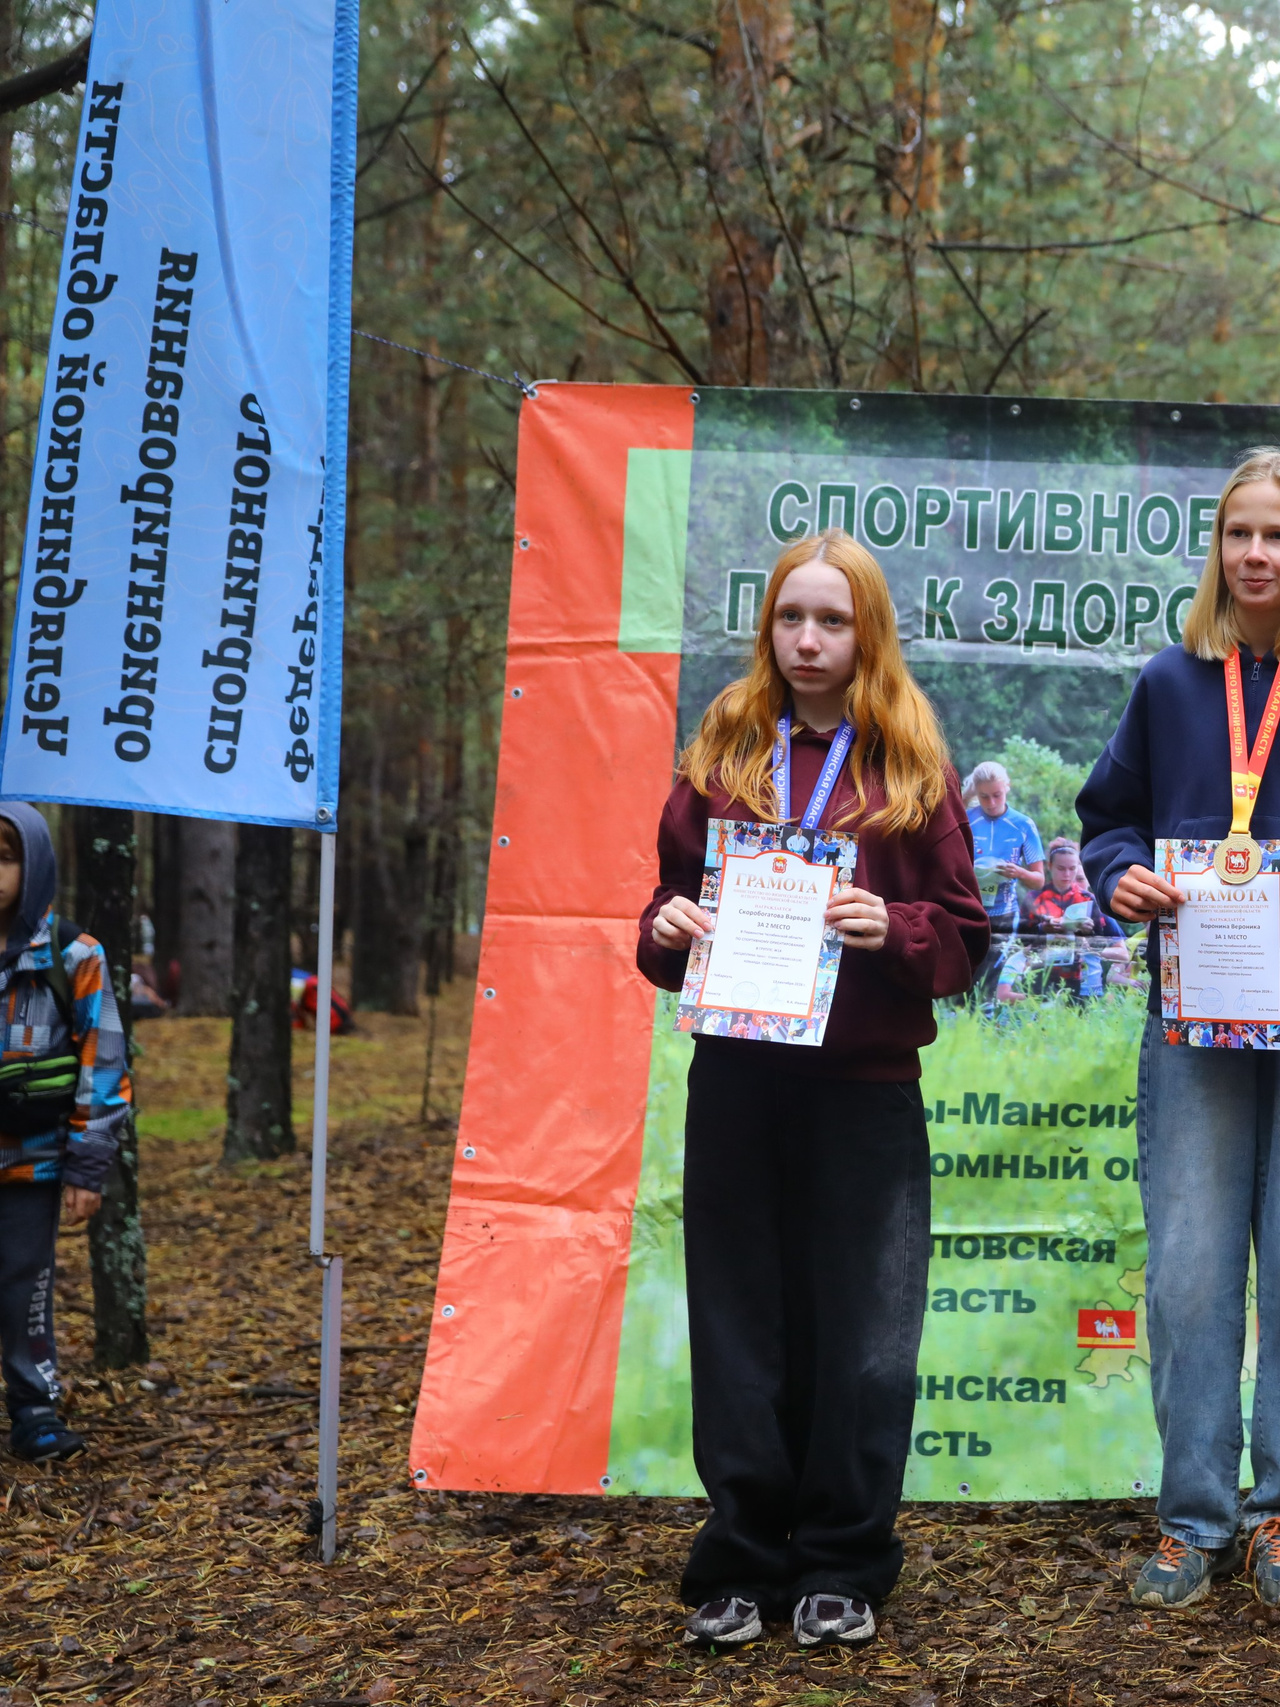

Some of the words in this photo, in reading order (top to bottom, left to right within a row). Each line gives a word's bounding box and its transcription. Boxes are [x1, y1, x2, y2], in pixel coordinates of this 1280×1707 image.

[769, 481, 1221, 559] СПОРТИВНОЕ
[924, 577, 962, 641] К
[1228, 655, 1239, 688] ОБЛАС
[1229, 689, 1243, 757] ЧЕЛЯБИНСКАЯ
[1256, 711, 1277, 758] ОБЛАСТЬ
[821, 724, 853, 789] ЧЕЛЯБИНСКАЯ
[805, 788, 827, 830] ОБЛАСТ
[735, 872, 818, 894] ГРАМОТА
[1186, 888, 1269, 902] ГРАМОТА
[738, 908, 784, 920] Скоробогатова
[785, 913, 812, 922] Варвара
[770, 923, 791, 931] МЕСТО
[930, 1147, 1089, 1182] омный
[928, 1235, 1116, 1264] ловская
[27, 1267, 52, 1337] SPORTS
[925, 1287, 1036, 1314] асть
